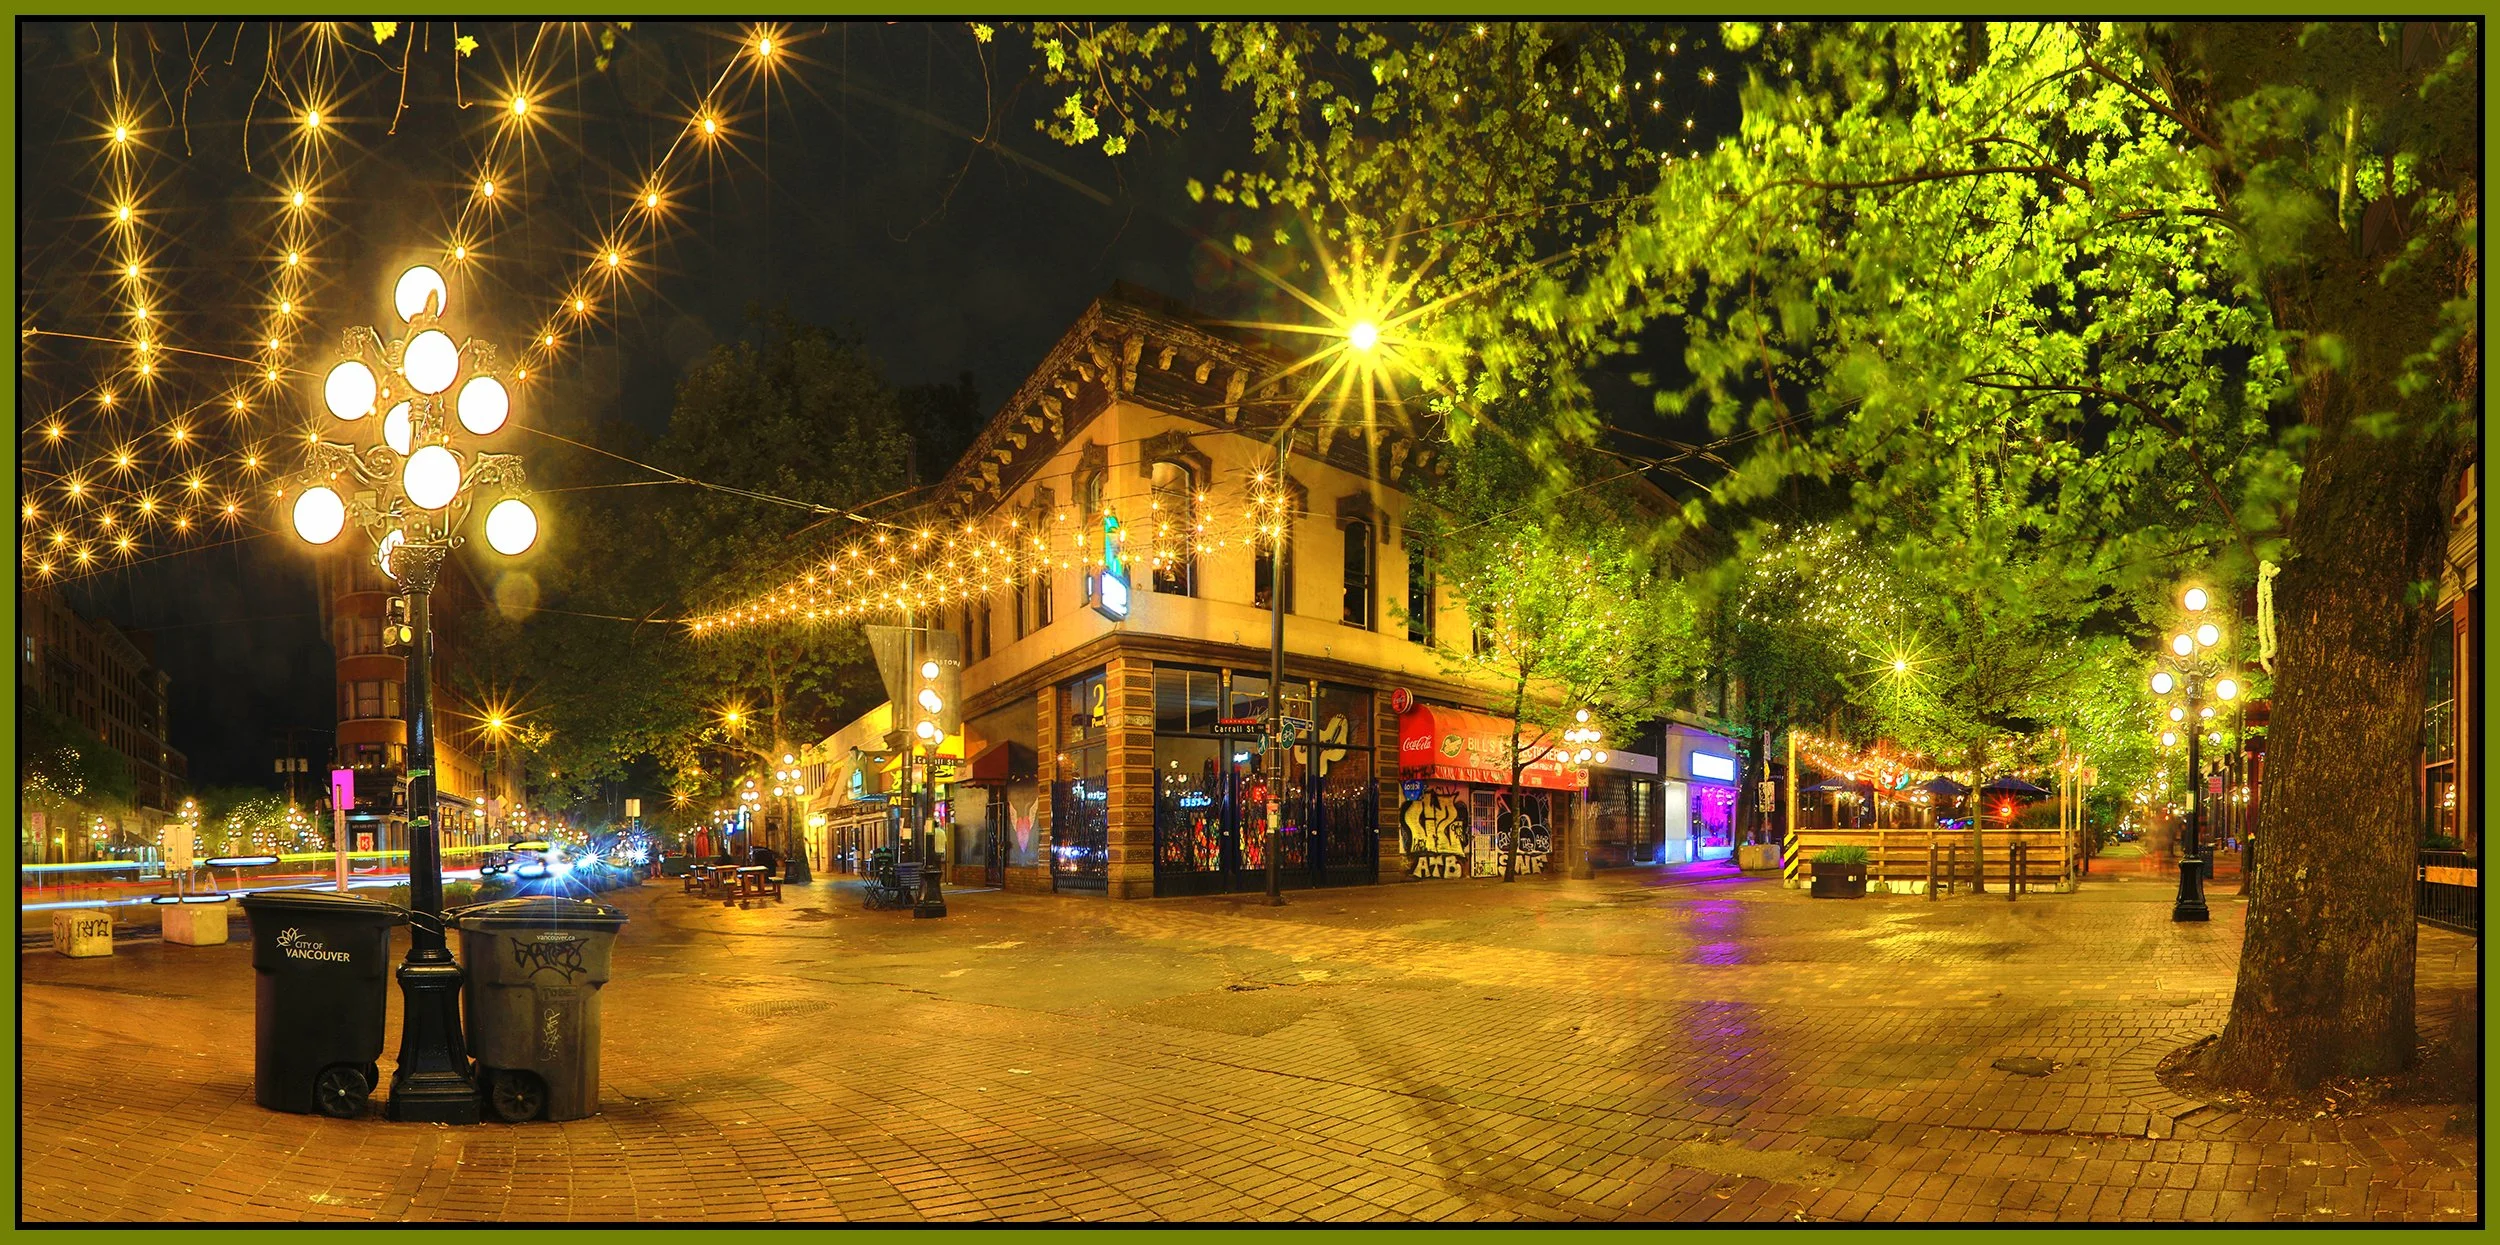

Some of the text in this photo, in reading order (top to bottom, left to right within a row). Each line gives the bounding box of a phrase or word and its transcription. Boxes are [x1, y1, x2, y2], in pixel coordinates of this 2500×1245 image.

[1093, 683, 1105, 718] 2
[1214, 725, 1243, 733] Carrall
[1246, 725, 1255, 733] St
[1467, 737, 1495, 753] BILL'S
[917, 756, 944, 764] Call
[1413, 854, 1463, 878] ATB
[536, 934, 576, 942] vancouver.ca
[295, 941, 323, 950] CITY OF
[285, 948, 351, 962] VANCOUVER
